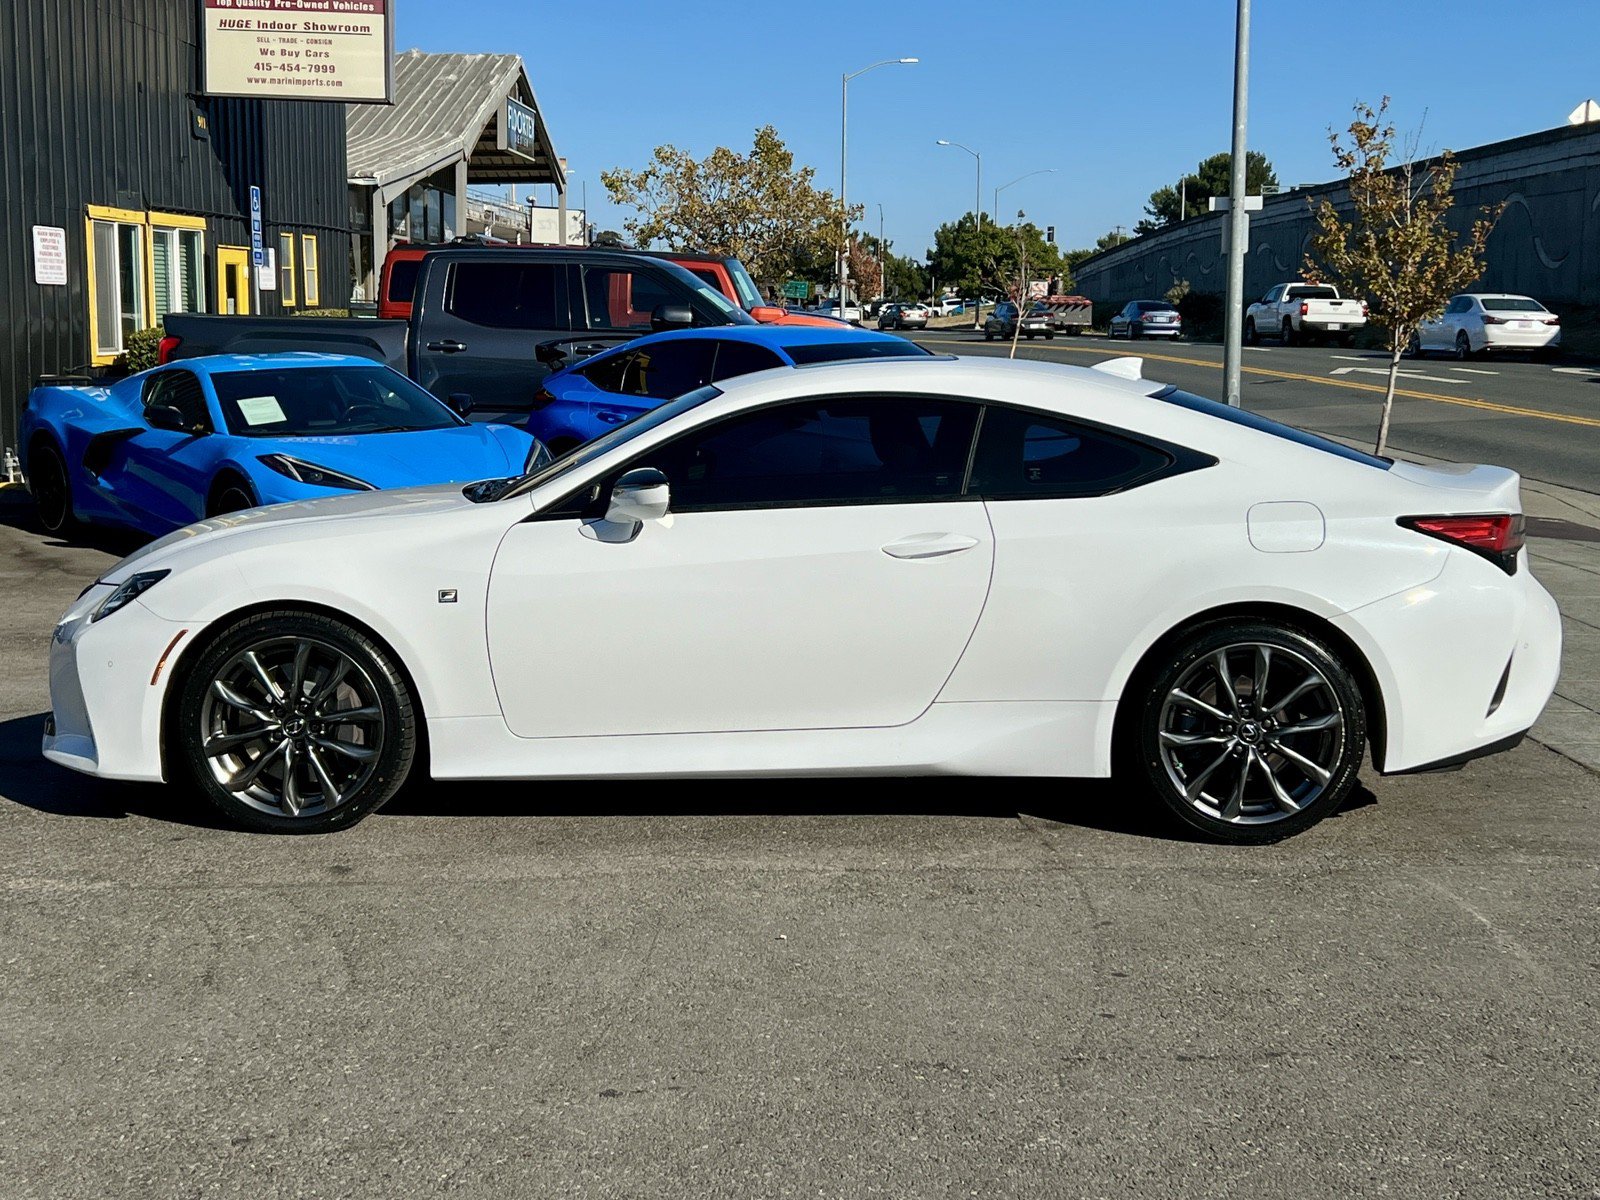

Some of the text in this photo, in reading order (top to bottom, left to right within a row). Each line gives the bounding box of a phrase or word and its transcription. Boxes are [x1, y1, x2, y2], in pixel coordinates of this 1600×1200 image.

[236, 0, 270, 8] Quality
[274, 0, 329, 10] Pre-Owned
[333, 2, 375, 11] Vehicles
[219, 19, 371, 33] HUGE Indoor Showroom
[259, 47, 330, 58] We Buy Cars
[253, 62, 336, 74] 415-454-7999
[246, 77, 343, 87] www.marinimports.com
